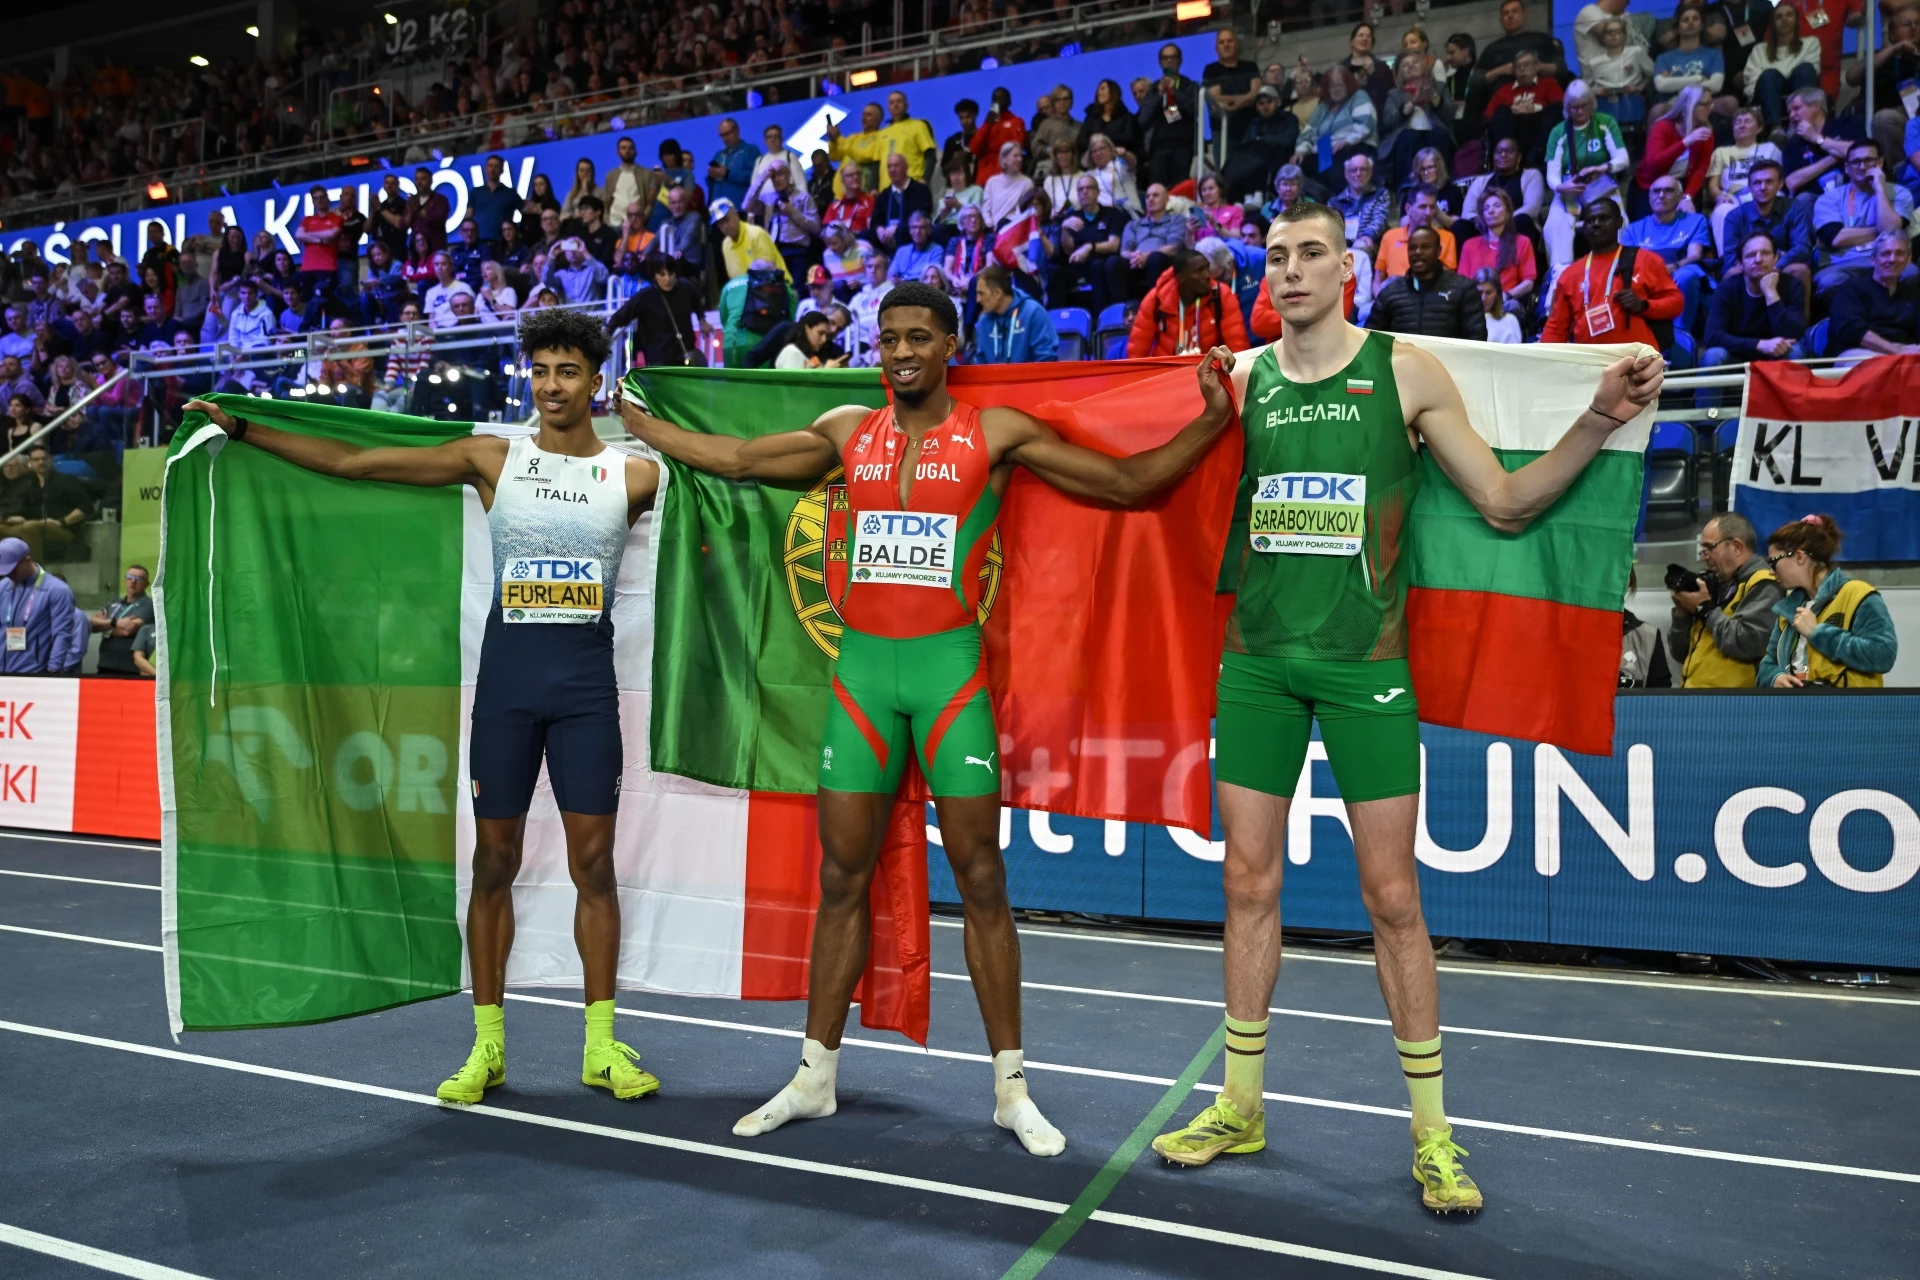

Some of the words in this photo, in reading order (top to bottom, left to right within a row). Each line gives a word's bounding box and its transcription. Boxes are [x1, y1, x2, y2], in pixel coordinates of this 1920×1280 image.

[1266, 404, 1360, 428] BULGARIA
[1749, 423, 1822, 486] KL
[140, 486, 163, 500] WO
[535, 488, 589, 504] ITALIA
[1281, 477, 1356, 501] TDK
[882, 515, 948, 539] TDK
[858, 543, 946, 567] BALDÉ
[529, 560, 594, 580] TDK
[903, 573, 937, 582] POMORZE
[508, 585, 597, 605] FURLANI
[0, 763, 37, 803] KI
